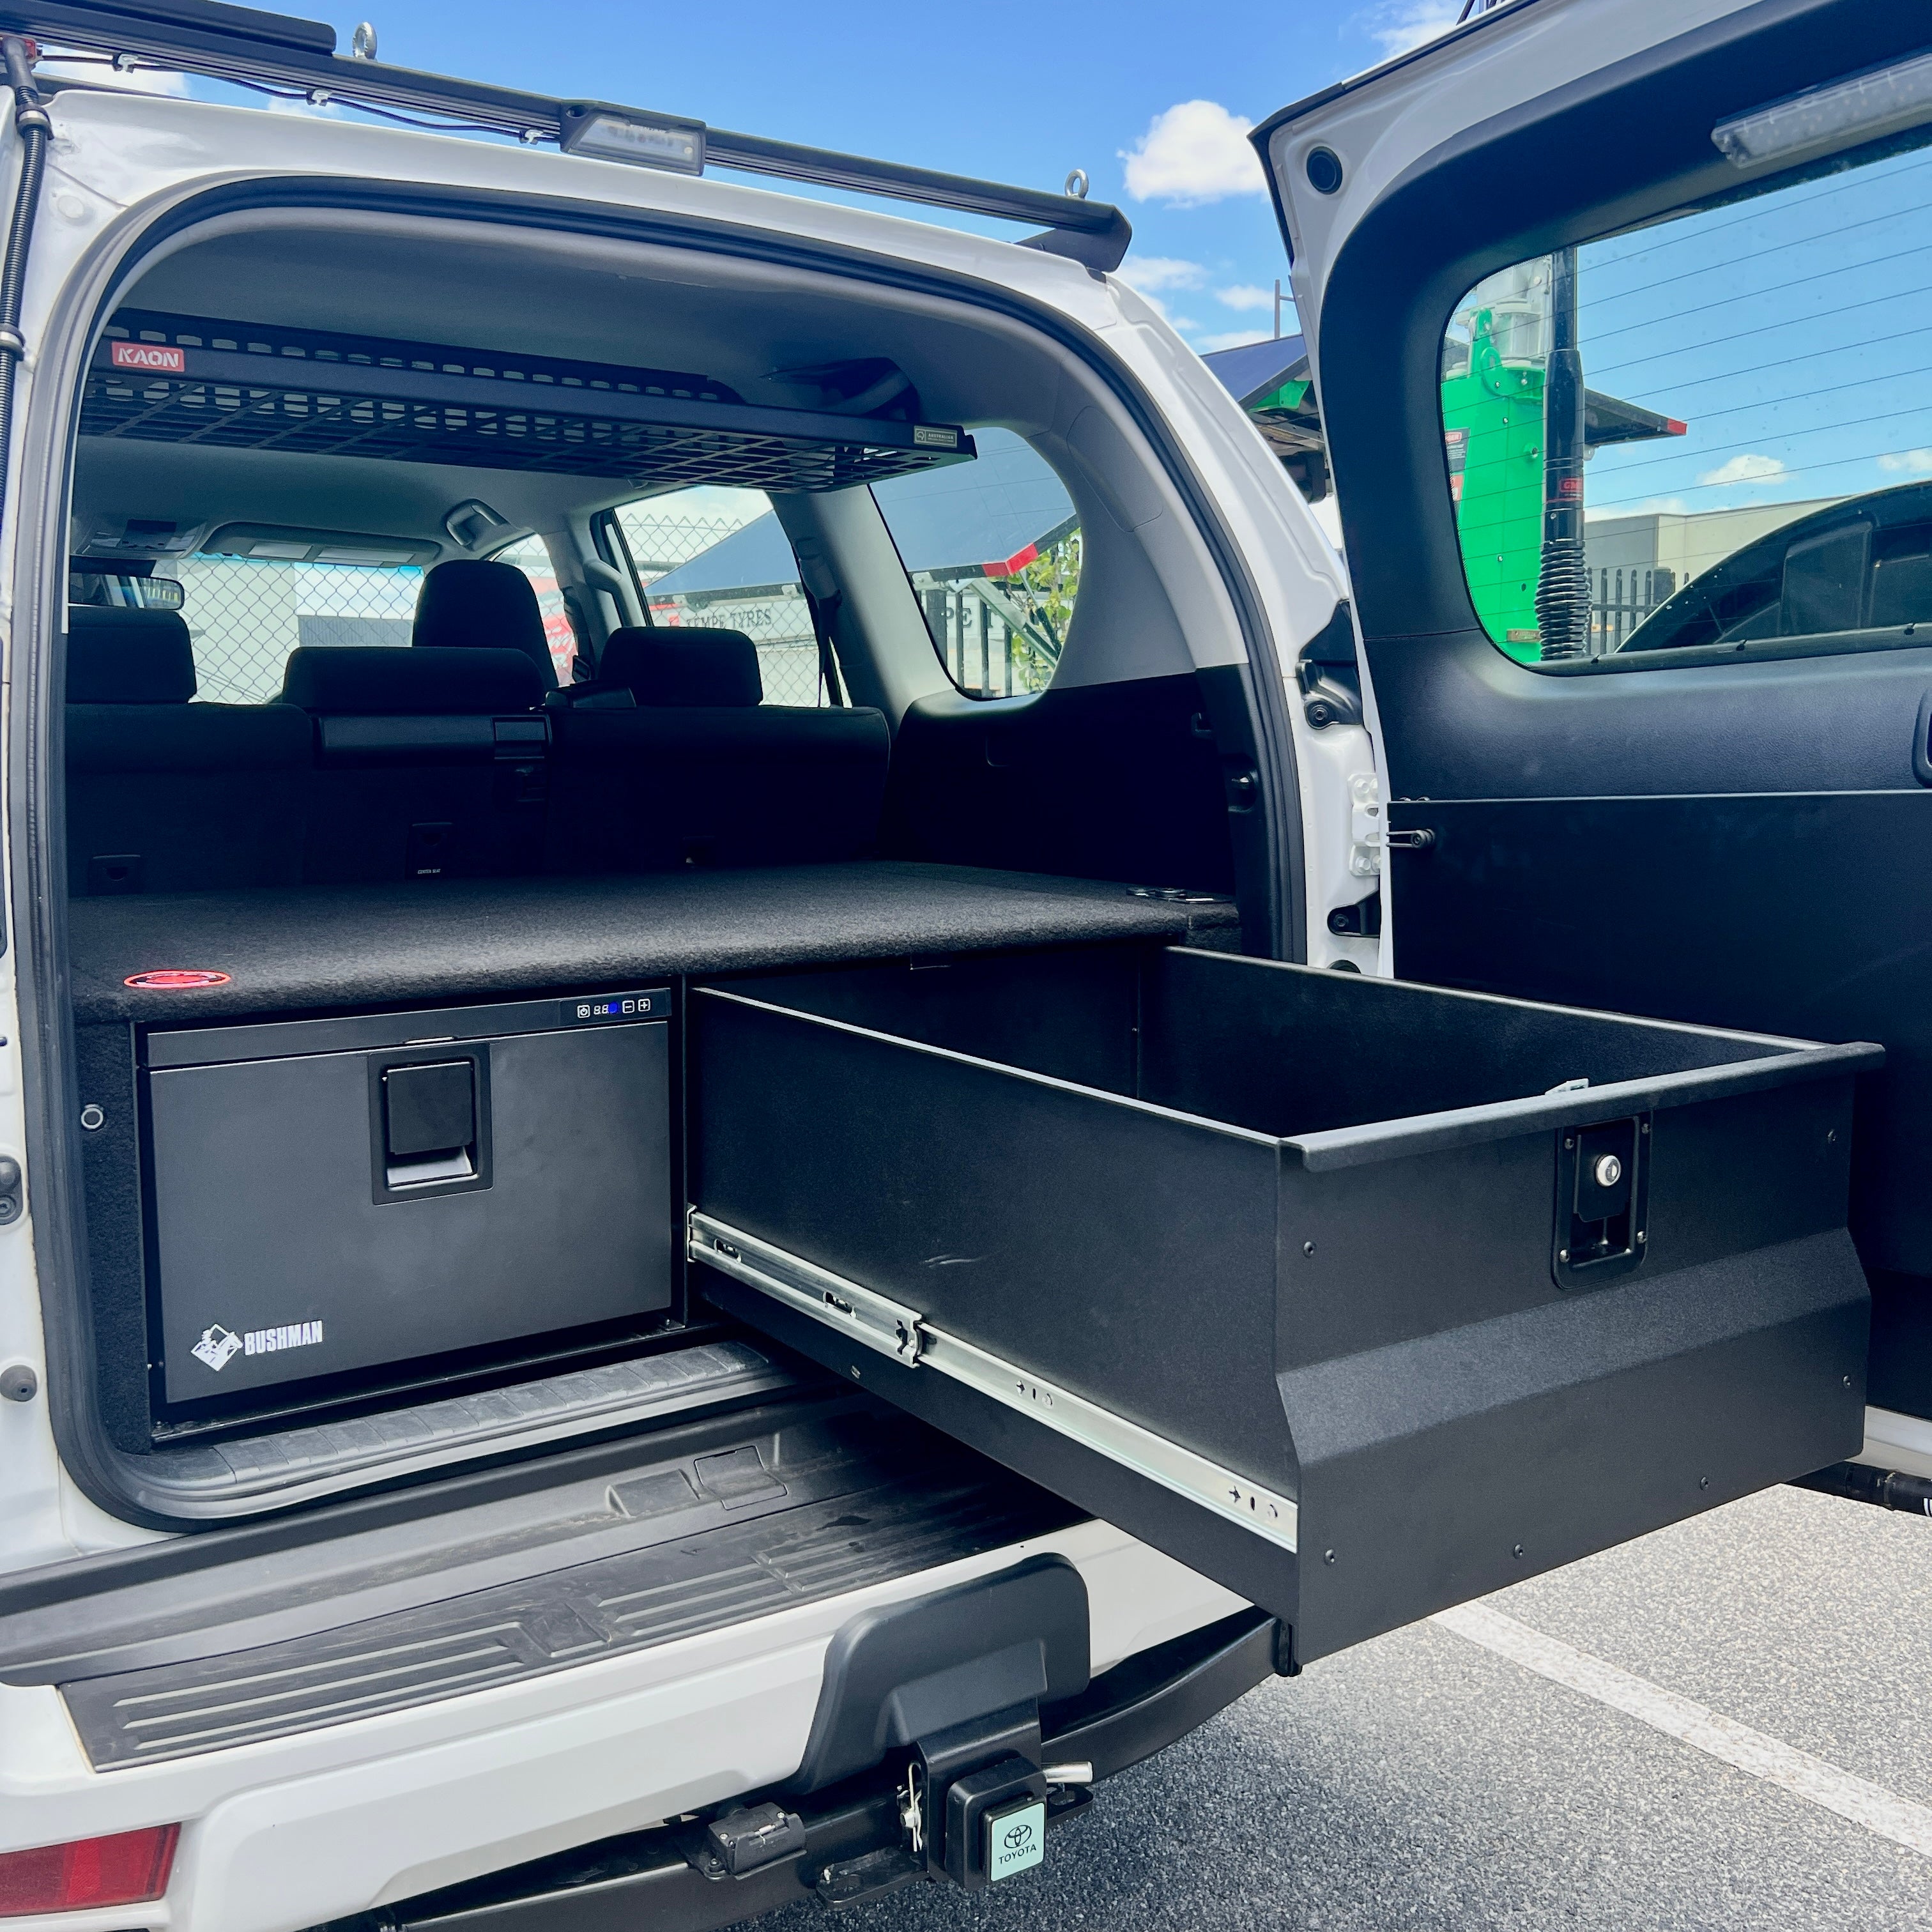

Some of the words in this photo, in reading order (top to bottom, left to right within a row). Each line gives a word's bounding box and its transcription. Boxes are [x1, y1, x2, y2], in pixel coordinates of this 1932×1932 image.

[118, 348, 179, 368] KAON
[731, 608, 772, 629] TYRES
[244, 1320, 323, 1355] BUSHMAN
[999, 1844, 1037, 1864] TOYOTA
